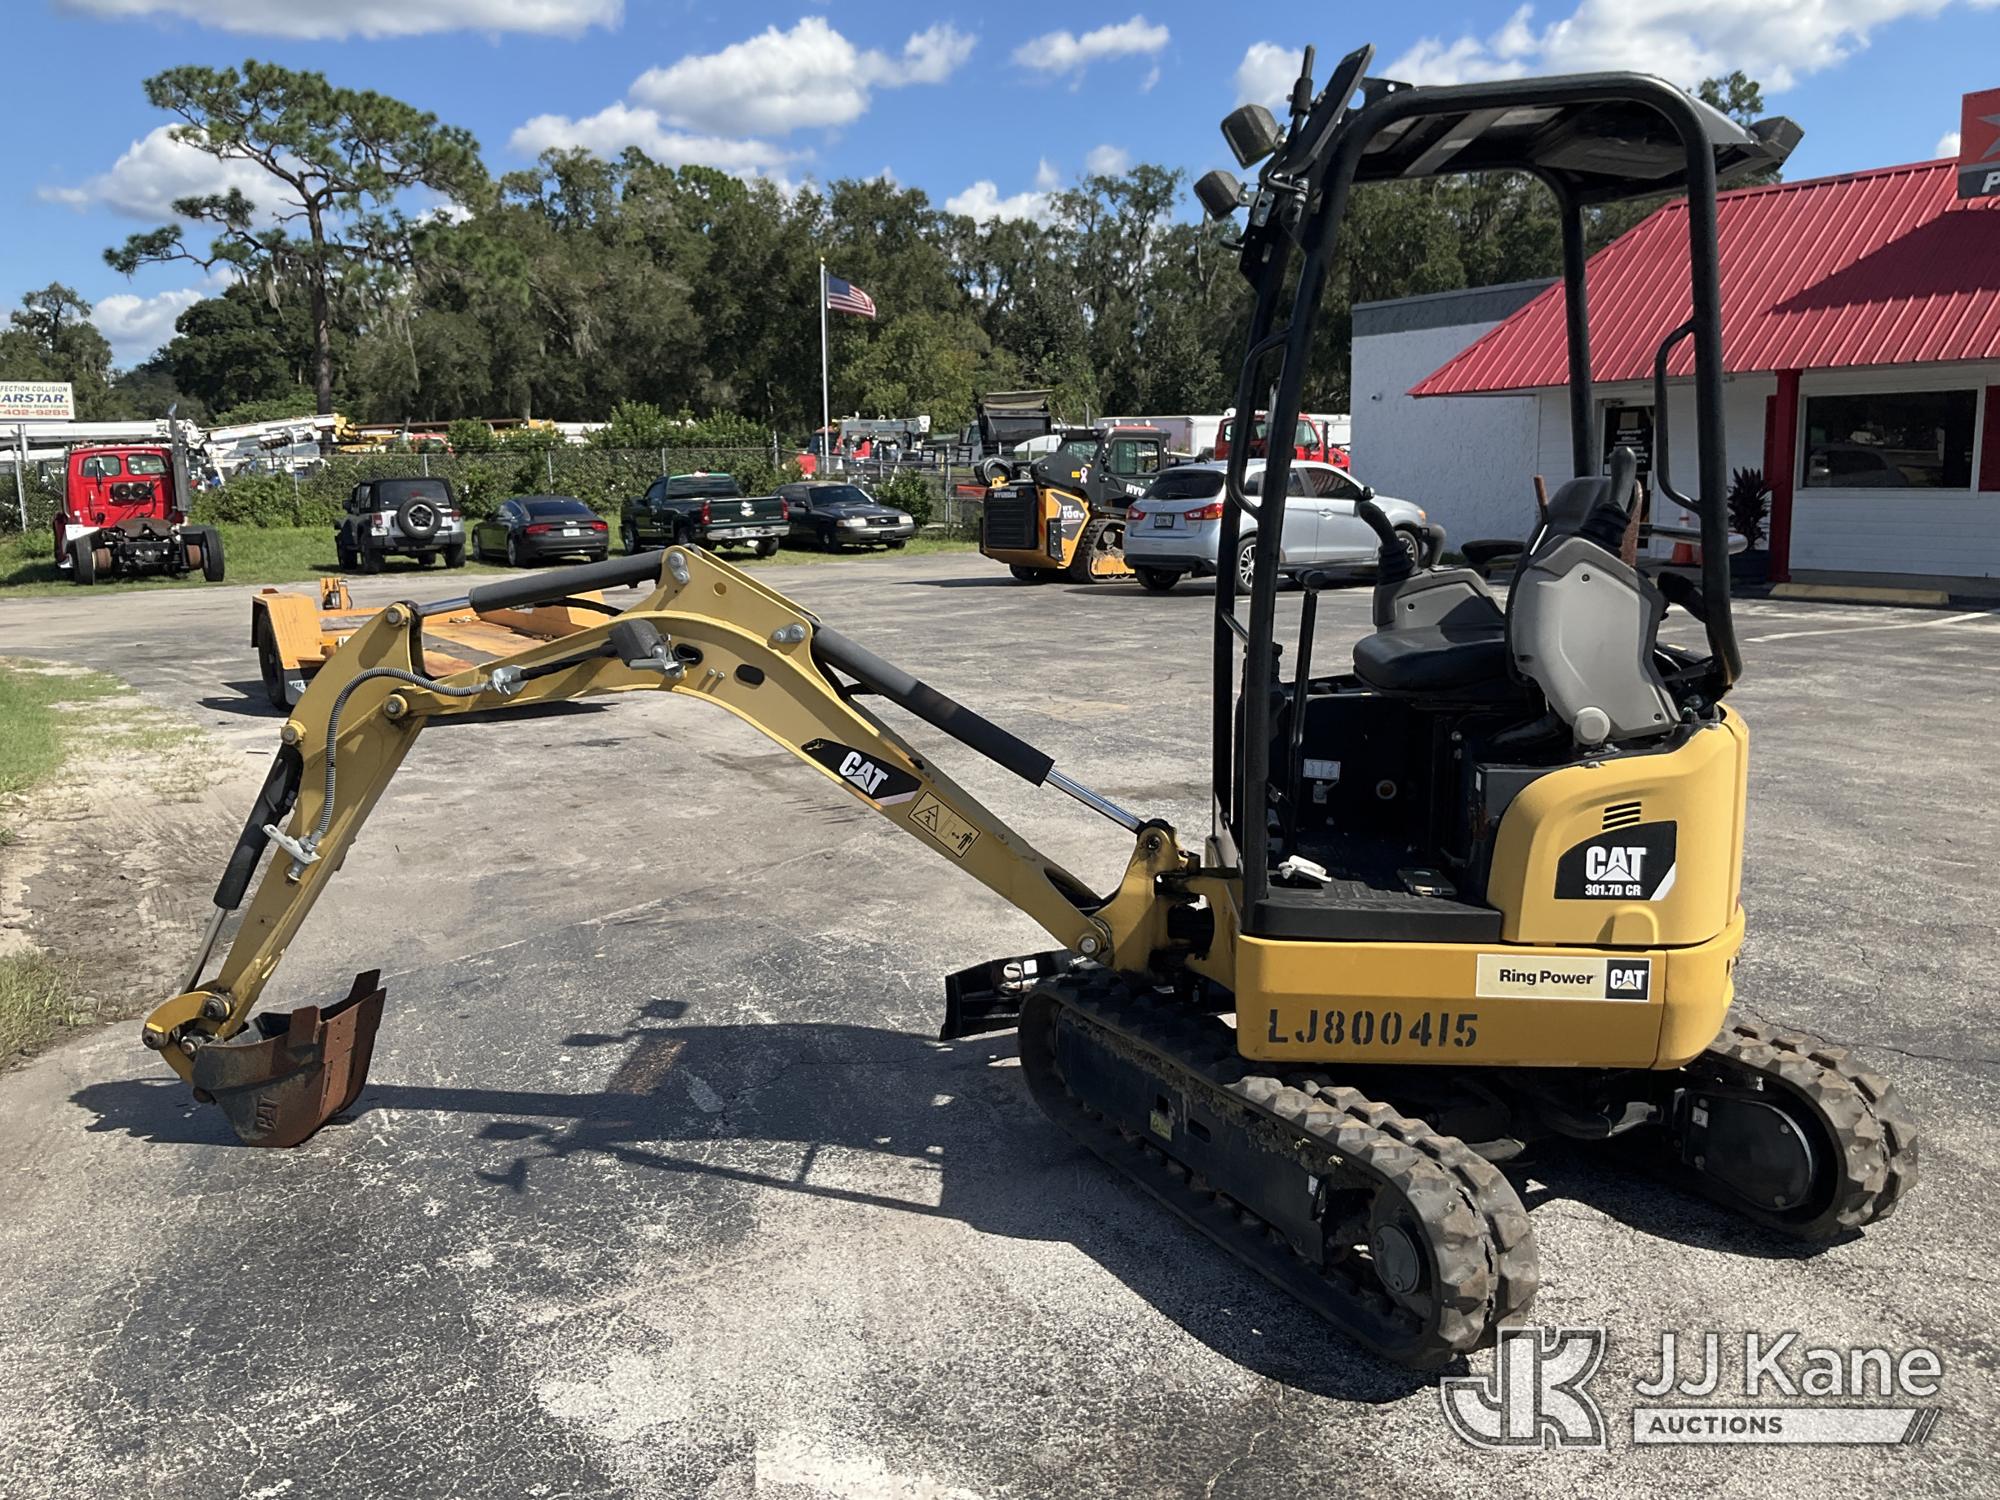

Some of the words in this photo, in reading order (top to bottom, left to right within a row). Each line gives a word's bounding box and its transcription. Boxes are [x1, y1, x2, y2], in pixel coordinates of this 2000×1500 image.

[0, 394, 64, 403] ARSTAR
[838, 751, 889, 795] CAT
[1585, 846, 1646, 881] CAT
[1585, 884, 1623, 896] 301.7D
[1625, 884, 1641, 896] CR
[1499, 968, 1537, 985] Ring
[1539, 970, 1594, 985] Power
[1610, 969, 1647, 990] CAT
[1268, 1009, 1478, 1048] LJ800415
